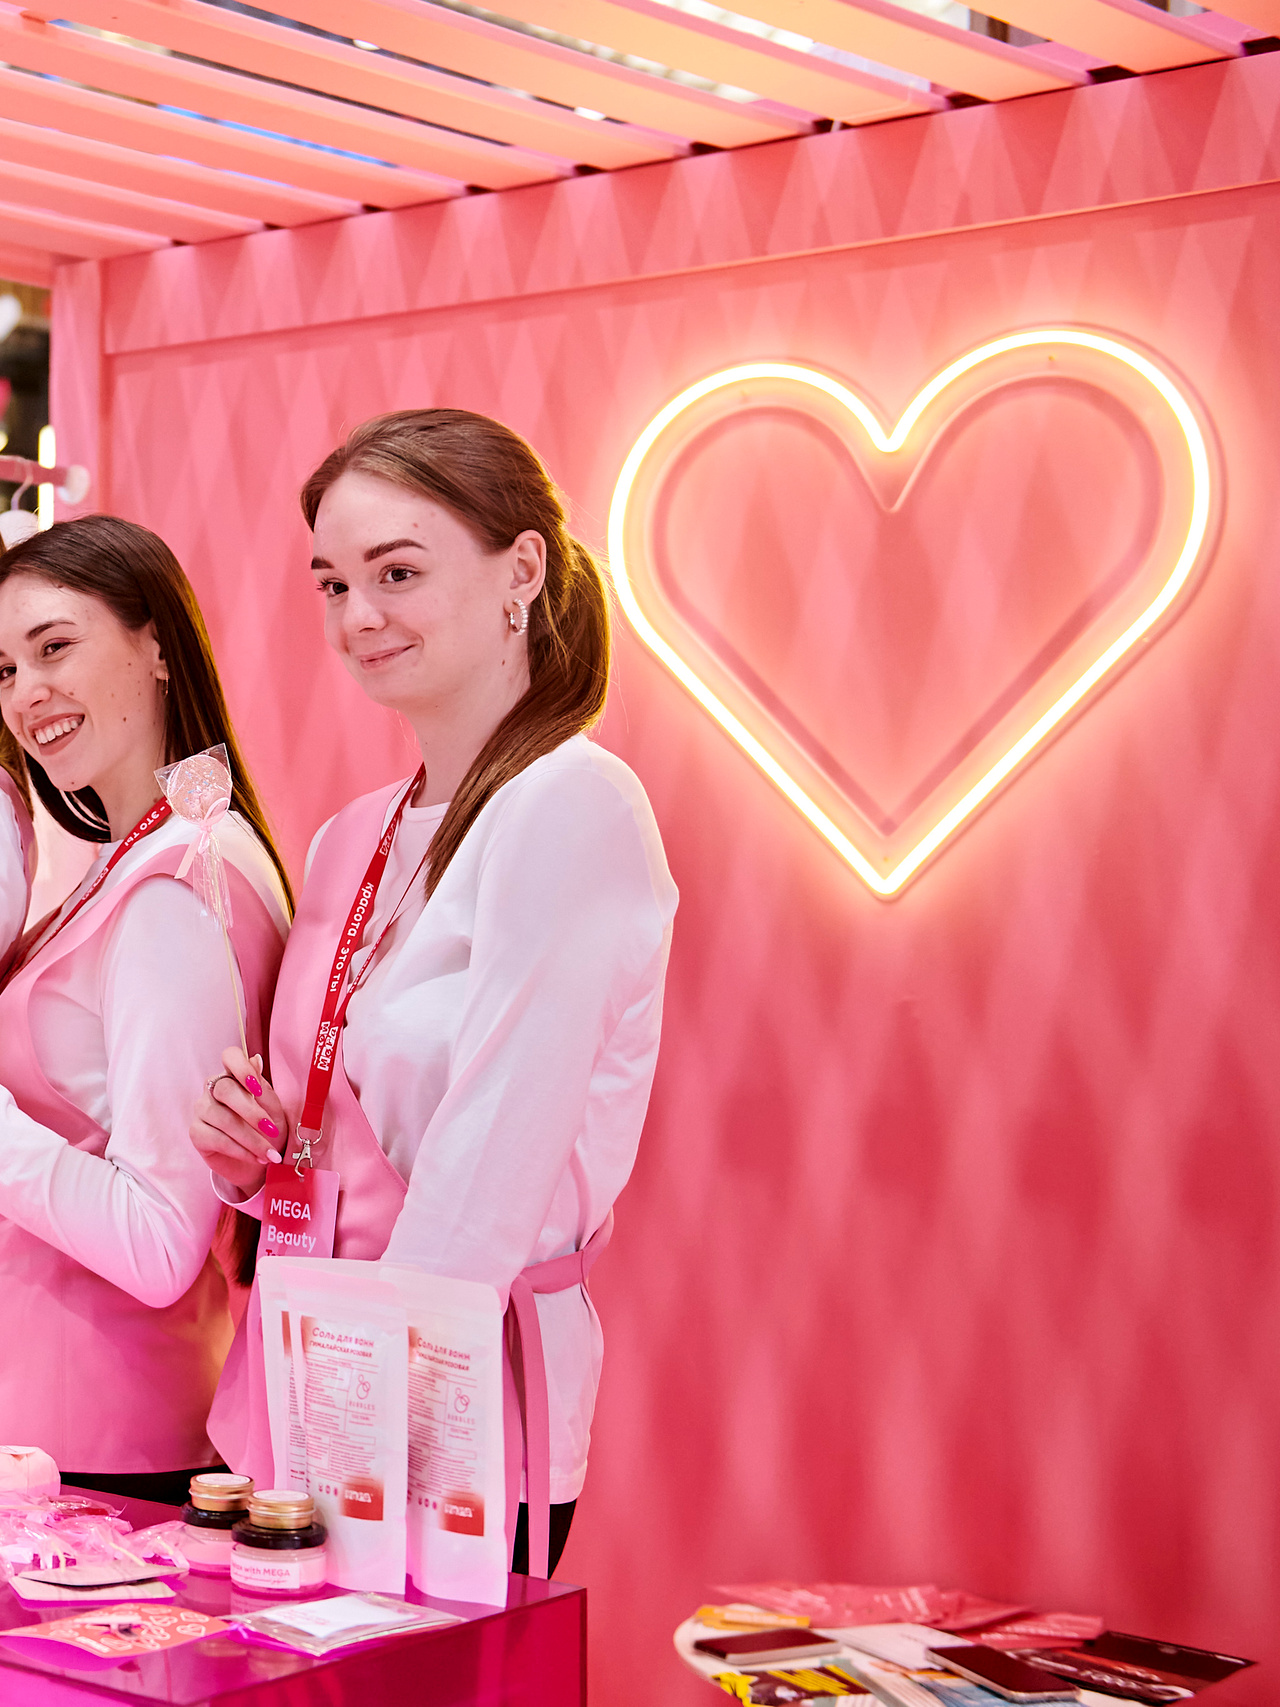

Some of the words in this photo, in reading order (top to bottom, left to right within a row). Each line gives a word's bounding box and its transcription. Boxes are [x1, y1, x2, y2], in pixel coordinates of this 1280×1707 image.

[348, 881, 375, 937] красота
[336, 947, 350, 970] это
[330, 973, 341, 992] ты
[270, 1198, 311, 1221] MEGA
[267, 1225, 316, 1253] Beauty
[244, 1567, 261, 1575] with
[263, 1568, 290, 1577] MEGA
